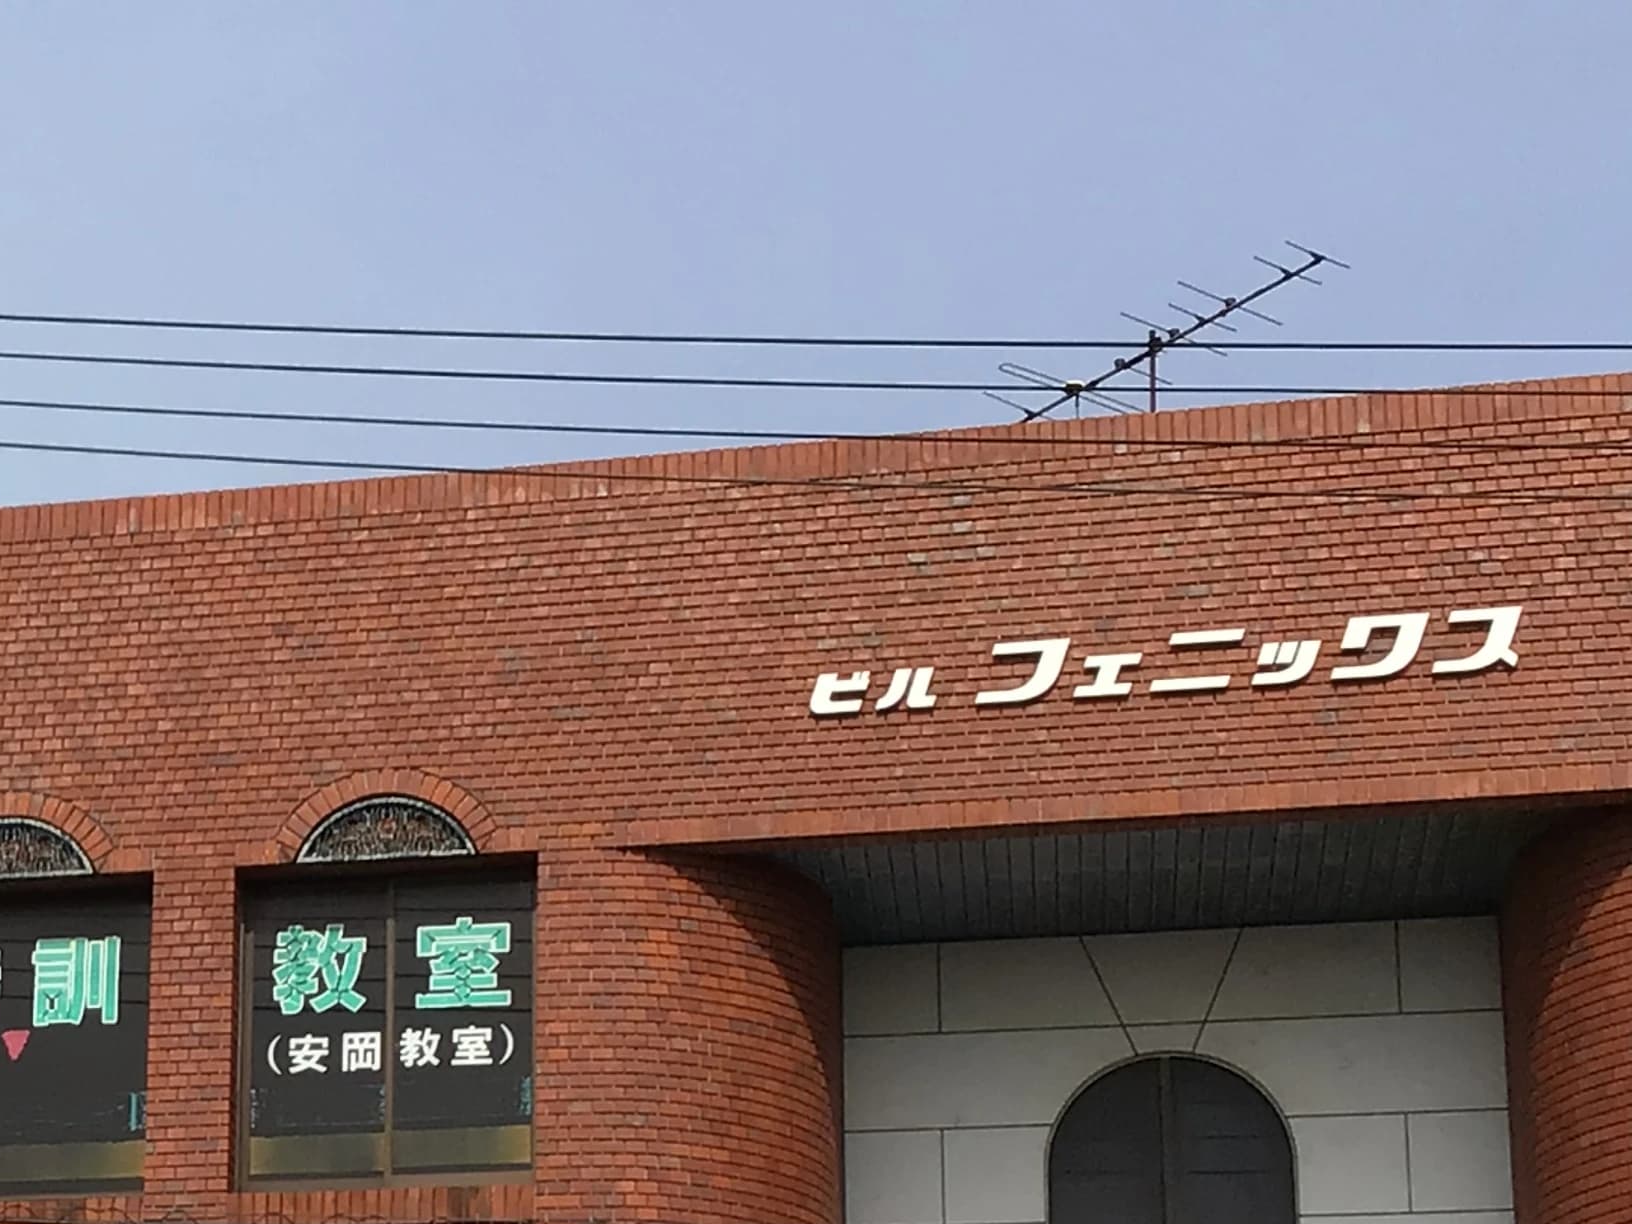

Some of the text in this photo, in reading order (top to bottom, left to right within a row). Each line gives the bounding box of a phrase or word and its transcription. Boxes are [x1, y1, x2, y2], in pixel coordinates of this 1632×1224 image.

[810, 606, 1524, 714] ビル フェニックス
[272, 916, 513, 1015] 教室
